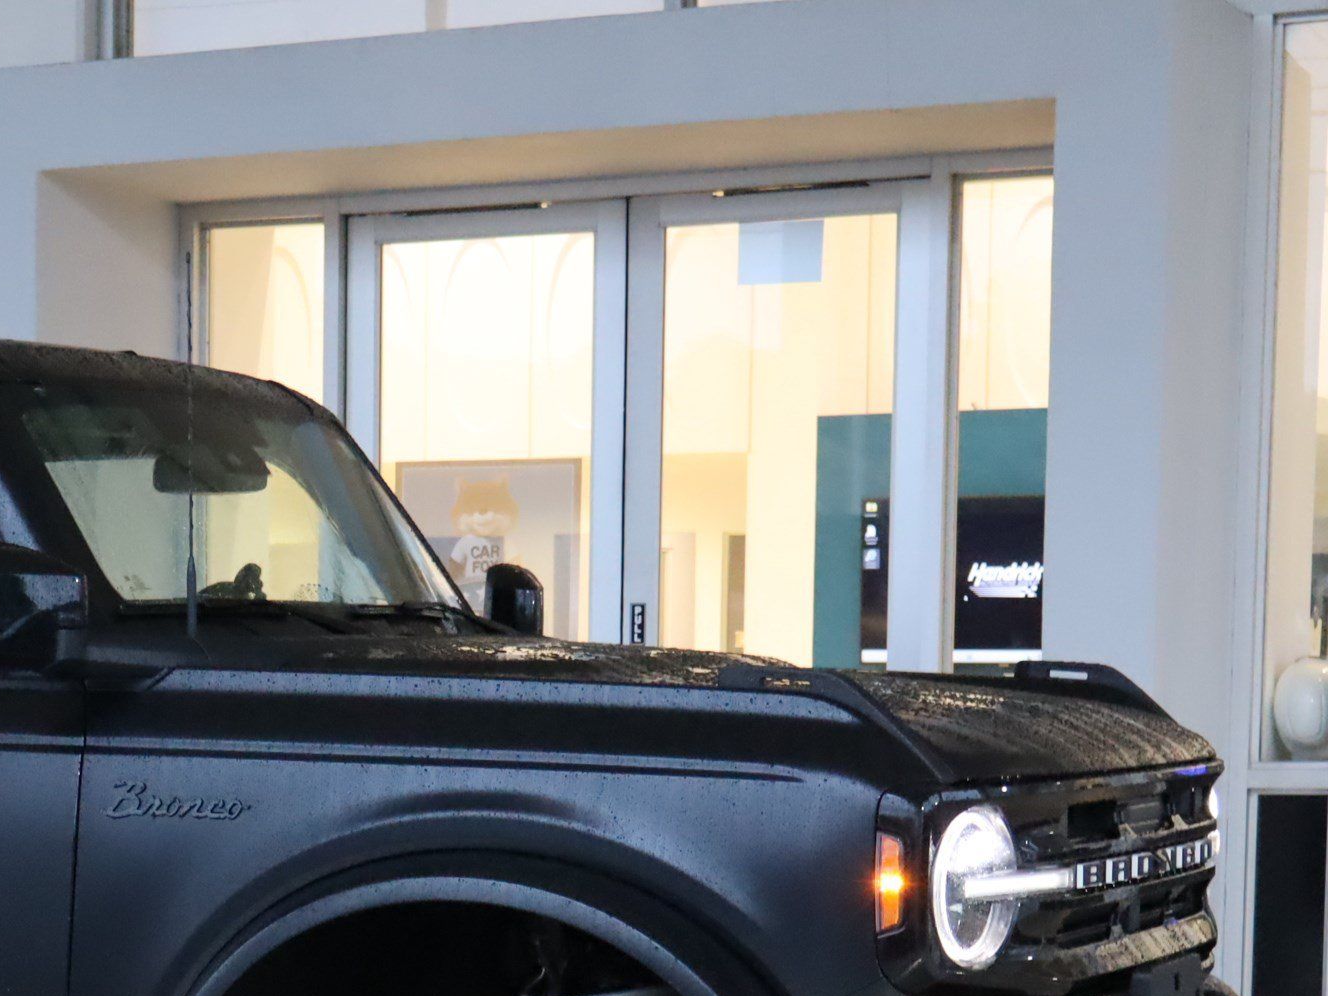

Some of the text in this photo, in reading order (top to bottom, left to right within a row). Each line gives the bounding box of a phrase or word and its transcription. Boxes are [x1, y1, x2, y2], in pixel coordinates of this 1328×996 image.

[470, 545, 500, 559] CAR
[472, 560, 498, 573] FO
[634, 605, 642, 643] PULL
[106, 781, 251, 820] Bronco
